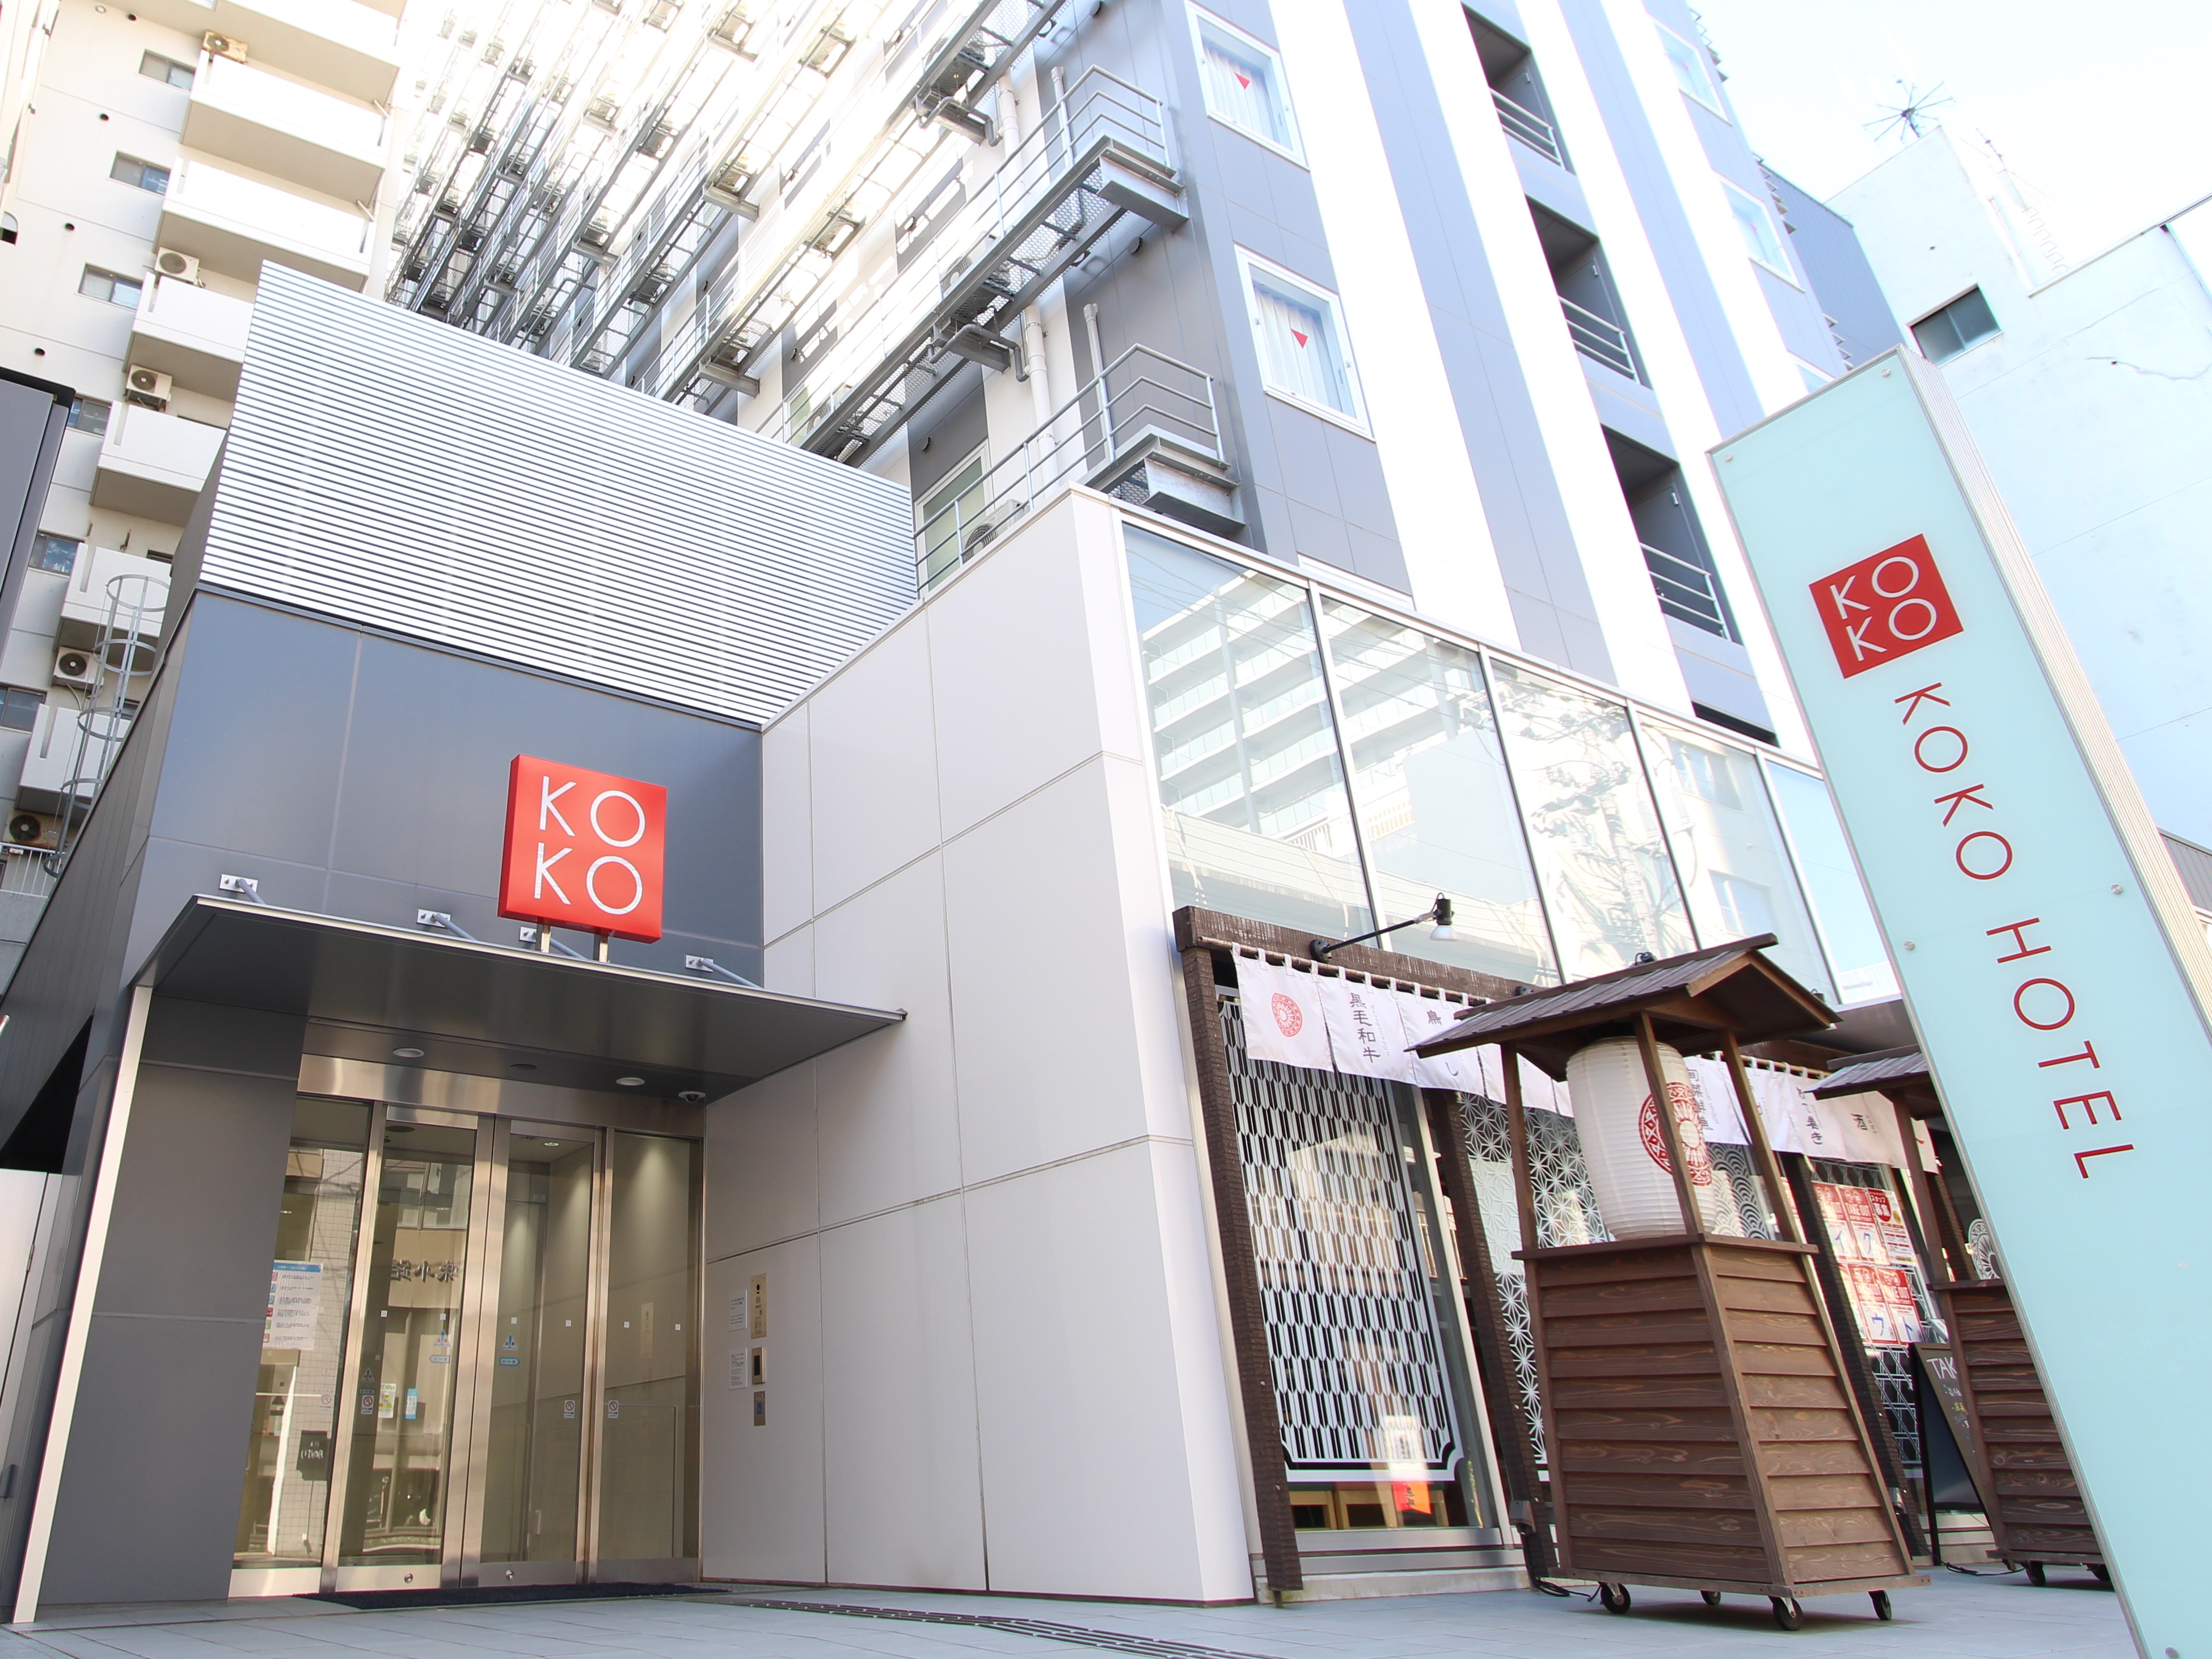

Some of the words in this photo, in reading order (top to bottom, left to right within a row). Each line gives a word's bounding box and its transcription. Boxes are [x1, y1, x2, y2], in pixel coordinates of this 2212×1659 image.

[1829, 555, 1920, 620] KO
[1846, 598, 1937, 662] KO
[539, 775, 646, 848] KO
[534, 842, 644, 915] KO
[1894, 682, 2013, 881] KOKO
[1985, 917, 2135, 1179] HOTEL
[1349, 992, 1381, 1064] 黒毛和牛
[1851, 1113, 1868, 1132] 酒
[1871, 1312, 1885, 1337] ウ
